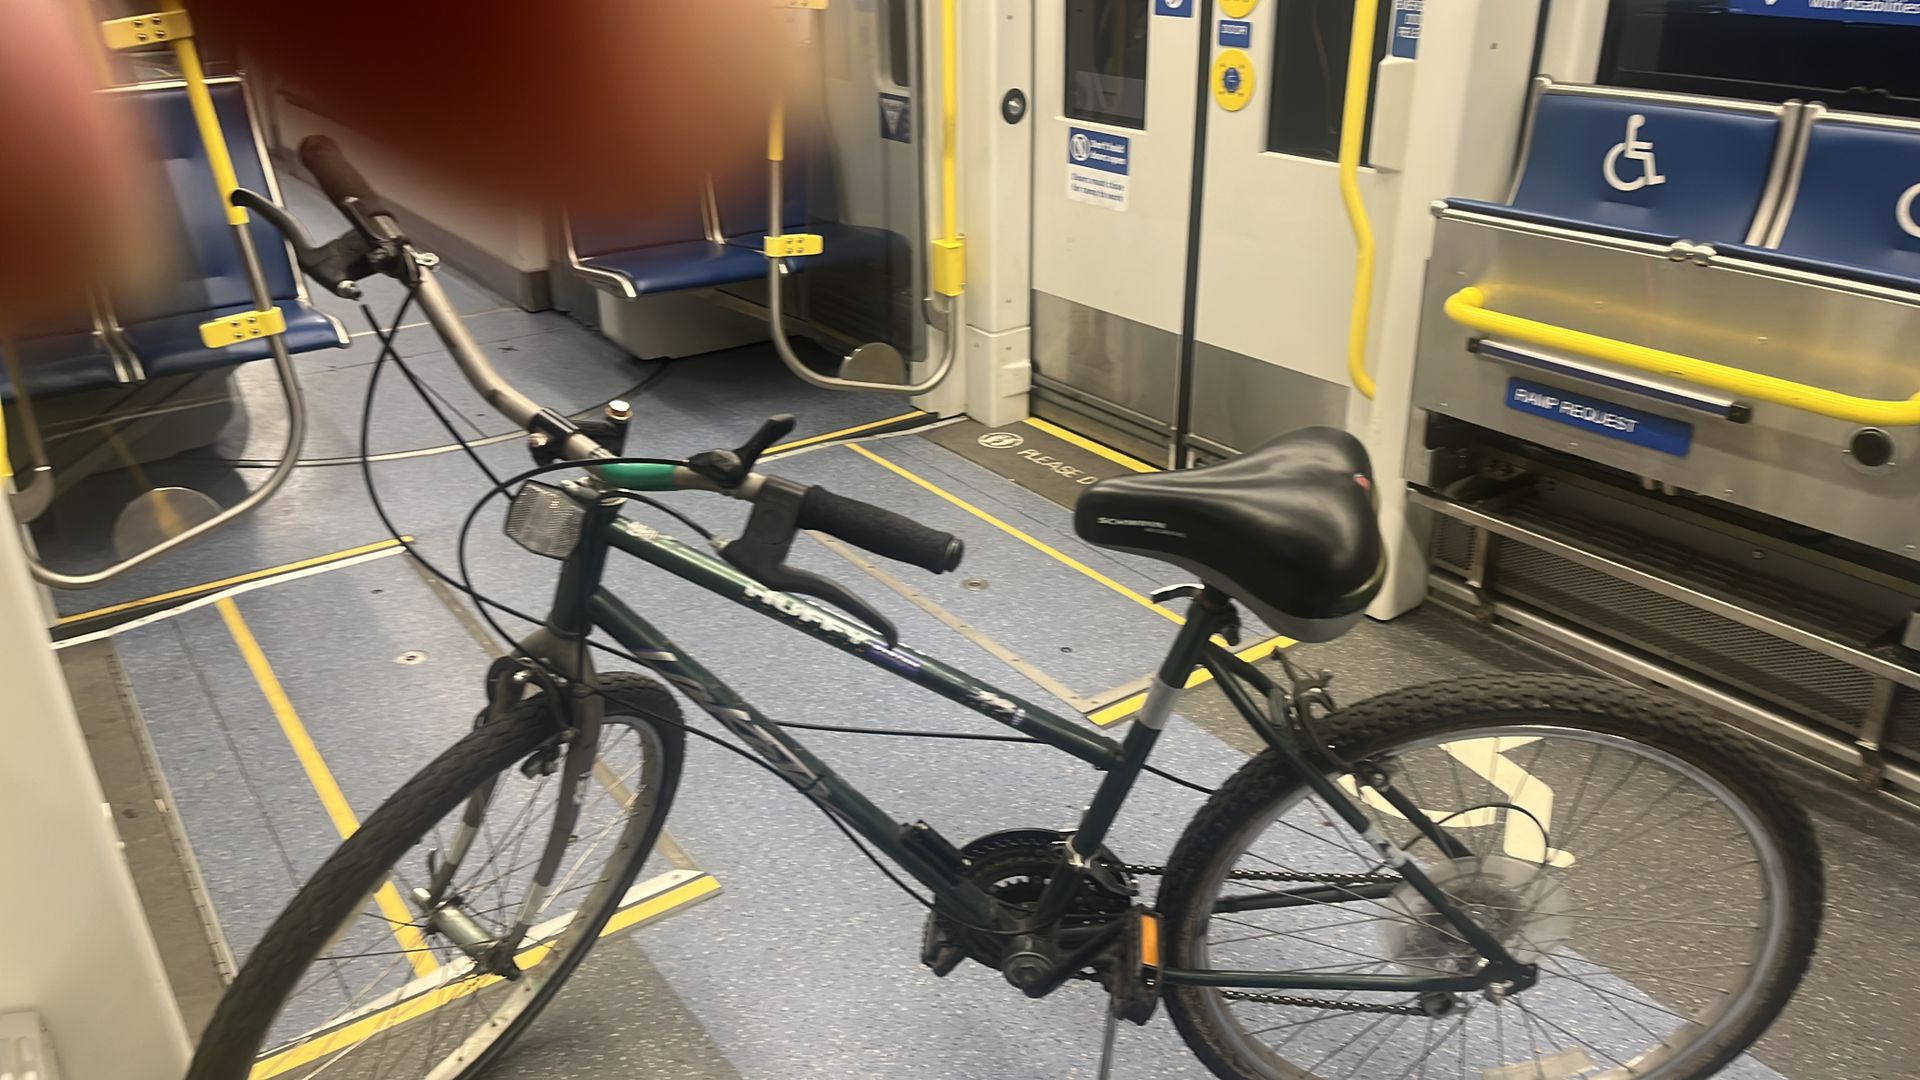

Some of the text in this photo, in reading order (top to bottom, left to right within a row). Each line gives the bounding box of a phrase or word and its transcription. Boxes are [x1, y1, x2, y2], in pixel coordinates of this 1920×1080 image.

[1514, 388, 1640, 433] RAMP REQUEST
[1016, 448, 1084, 479] PLEASE
